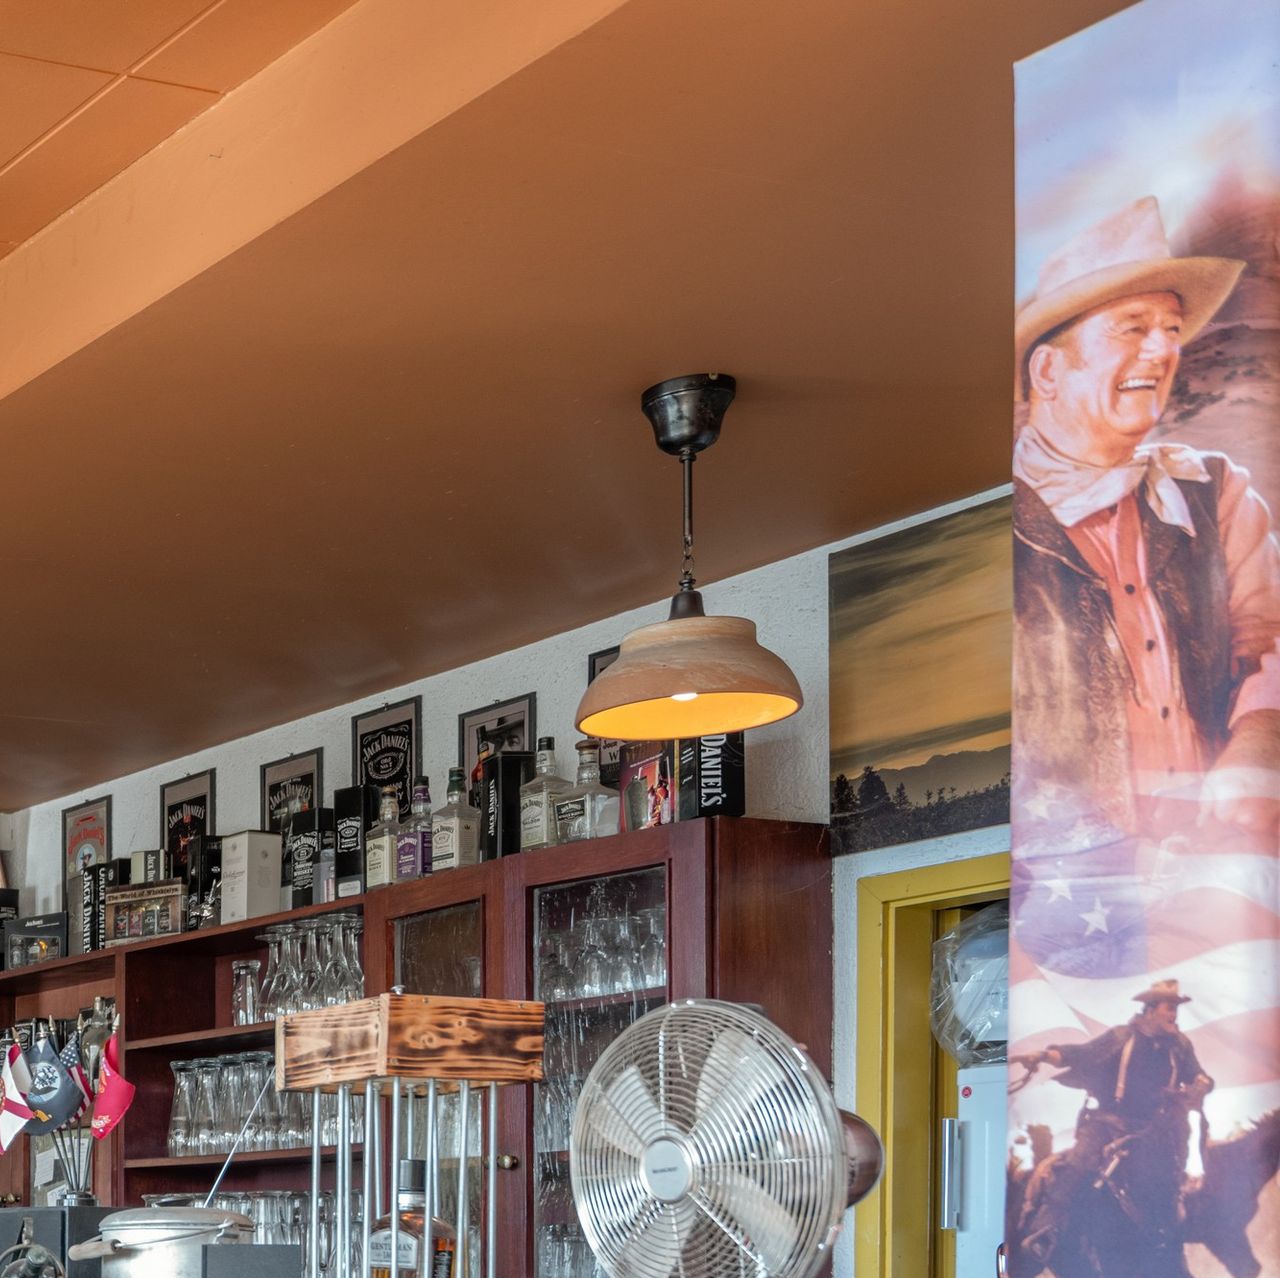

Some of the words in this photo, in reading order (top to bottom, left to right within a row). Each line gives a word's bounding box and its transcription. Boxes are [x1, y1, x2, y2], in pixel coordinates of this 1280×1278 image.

[363, 741, 381, 762] JACK
[381, 733, 410, 751] DANIEL'S
[269, 789, 286, 811] JACK
[168, 811, 182, 829] JACK
[183, 802, 206, 819] DANIEL'S
[83, 871, 93, 905] JACK
